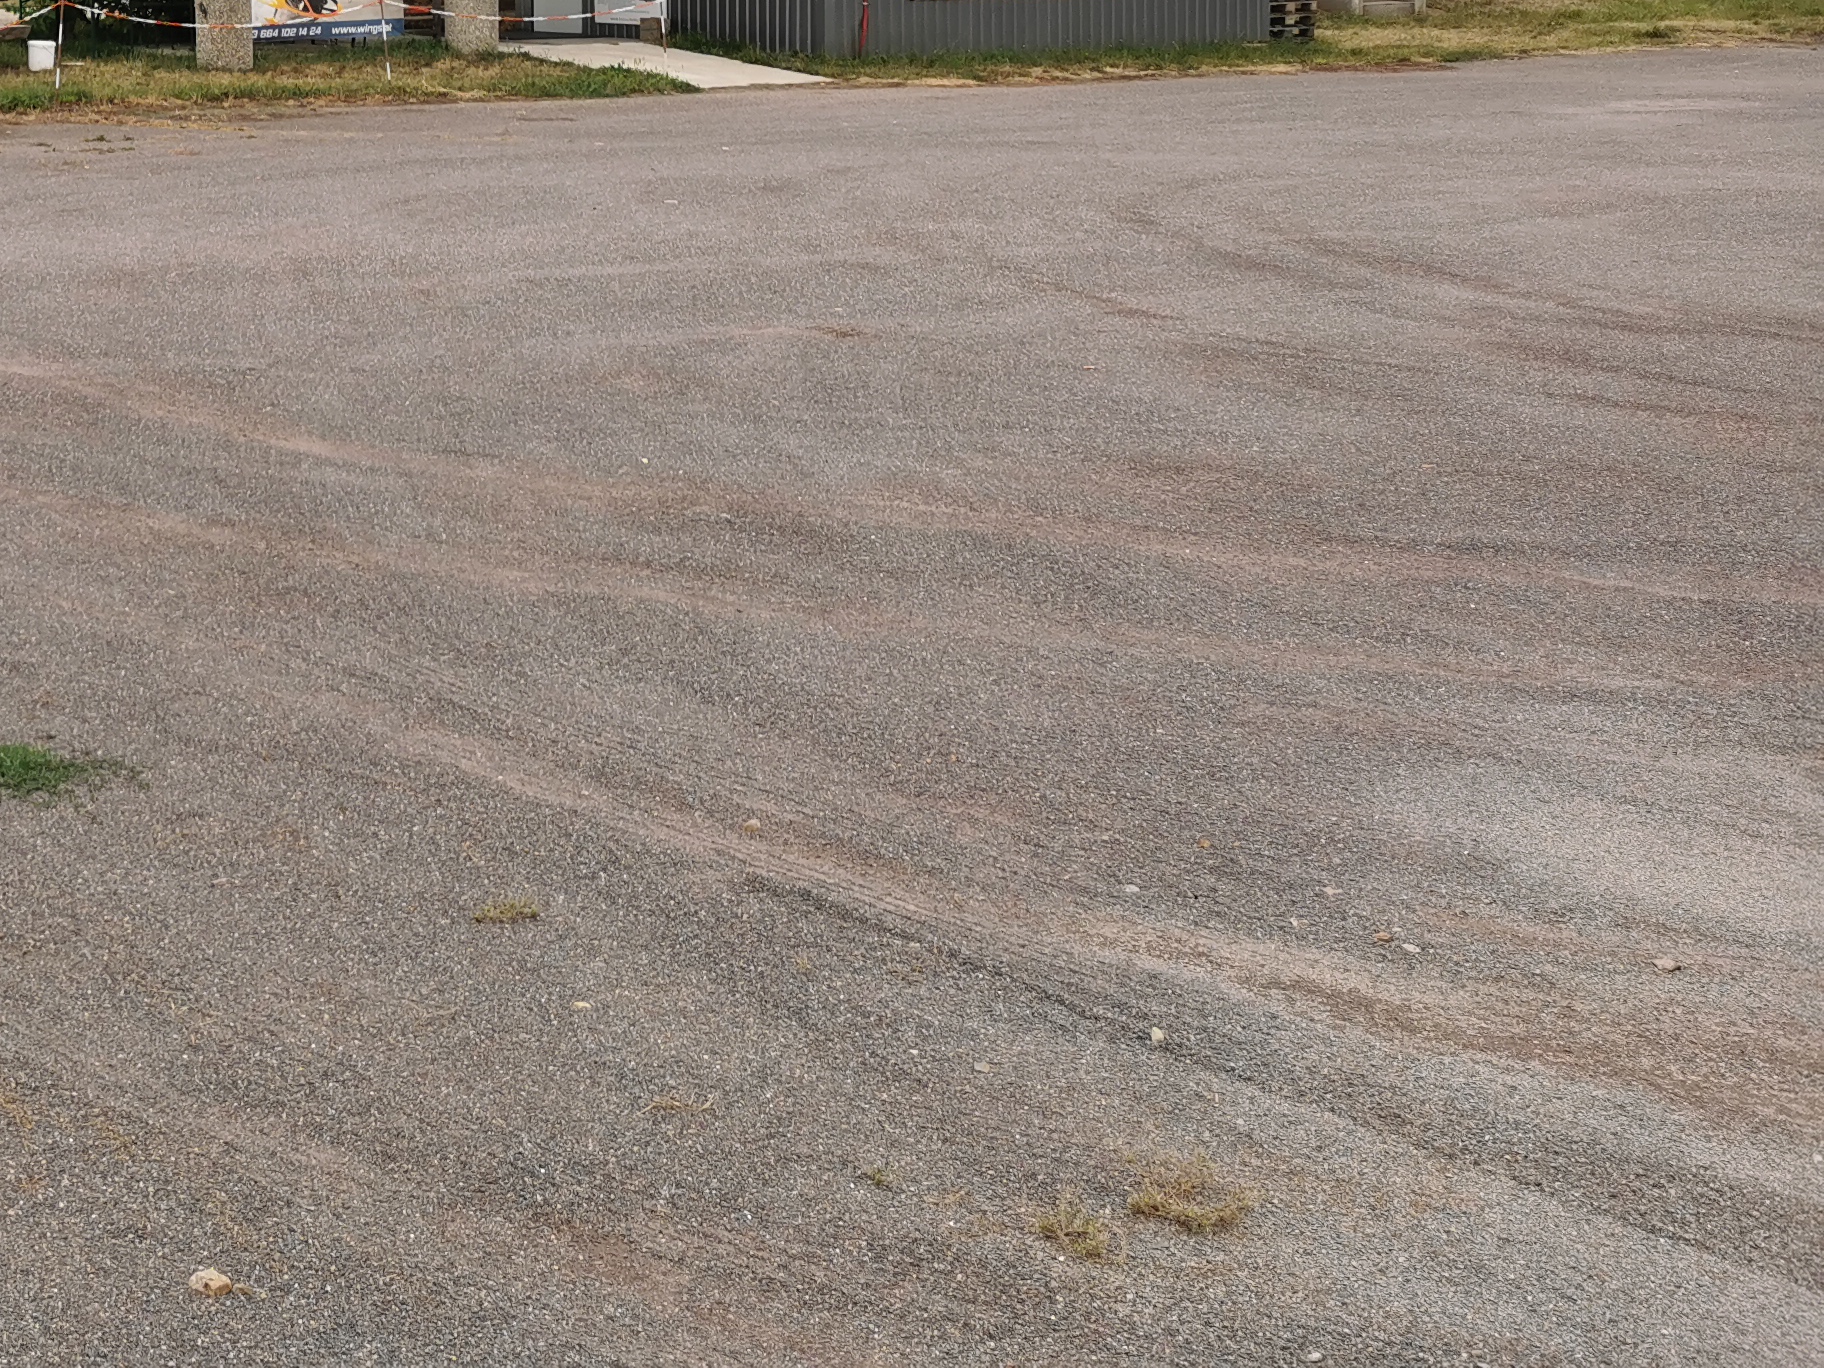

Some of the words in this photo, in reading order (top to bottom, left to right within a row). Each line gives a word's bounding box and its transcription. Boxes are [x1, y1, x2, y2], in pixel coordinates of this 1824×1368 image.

[281, 26, 297, 38] 102
[298, 26, 308, 36] 14
[309, 25, 322, 36] 24
[331, 22, 393, 36] www.wingsat
